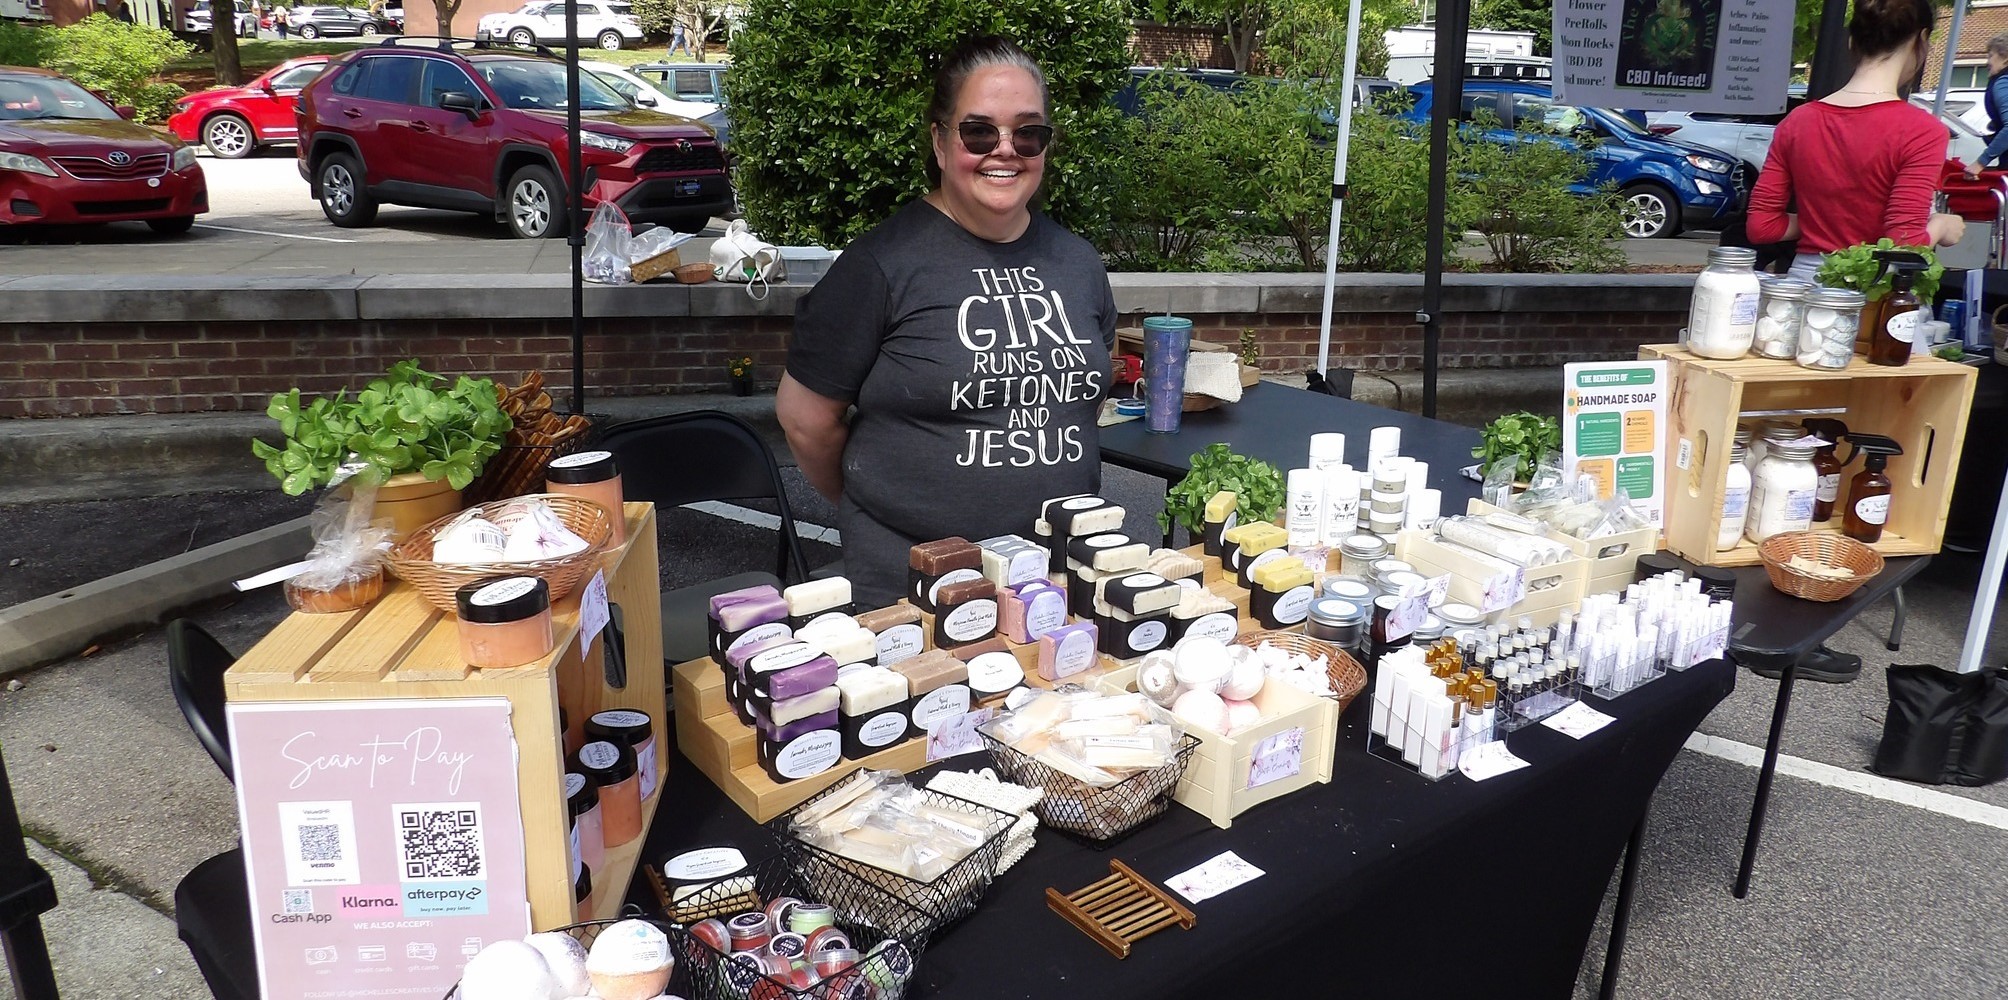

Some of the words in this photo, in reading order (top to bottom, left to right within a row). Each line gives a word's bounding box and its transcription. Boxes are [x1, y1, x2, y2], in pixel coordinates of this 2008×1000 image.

[1564, 17, 1609, 31] PreRolls
[1561, 35, 1581, 48] Mon
[1583, 37, 1615, 50] Rocks
[1577, 76, 1606, 87] more!
[1626, 69, 1651, 85] CBD
[1653, 71, 1707, 88] Infused!
[972, 266, 1045, 295] THIS
[957, 290, 1092, 351] GIRL
[973, 350, 1044, 374] RUNS
[1050, 345, 1087, 370] ON
[1580, 374, 1592, 383] THE
[1593, 373, 1620, 383] BENEFITS
[1620, 373, 1629, 382] OF
[951, 371, 1102, 411] KETONES
[1576, 394, 1630, 407] HANDMADE
[1631, 393, 1657, 404] SOAP
[1008, 407, 1050, 429] AND
[1626, 417, 1631, 426] 2
[955, 425, 1083, 467] JESUS
[1618, 463, 1625, 474] 4
[281, 731, 362, 789] Scan
[360, 734, 407, 788] to
[403, 726, 474, 796] Pay
[407, 888, 466, 901] afterpay
[342, 896, 399, 909] Klarna.
[271, 912, 302, 925] Cash
[306, 912, 333, 925] App
[354, 922, 369, 930] WE
[370, 921, 395, 929] ALSO
[398, 920, 434, 928] ACCEPT:
[304, 991, 335, 999] FOLLOW
